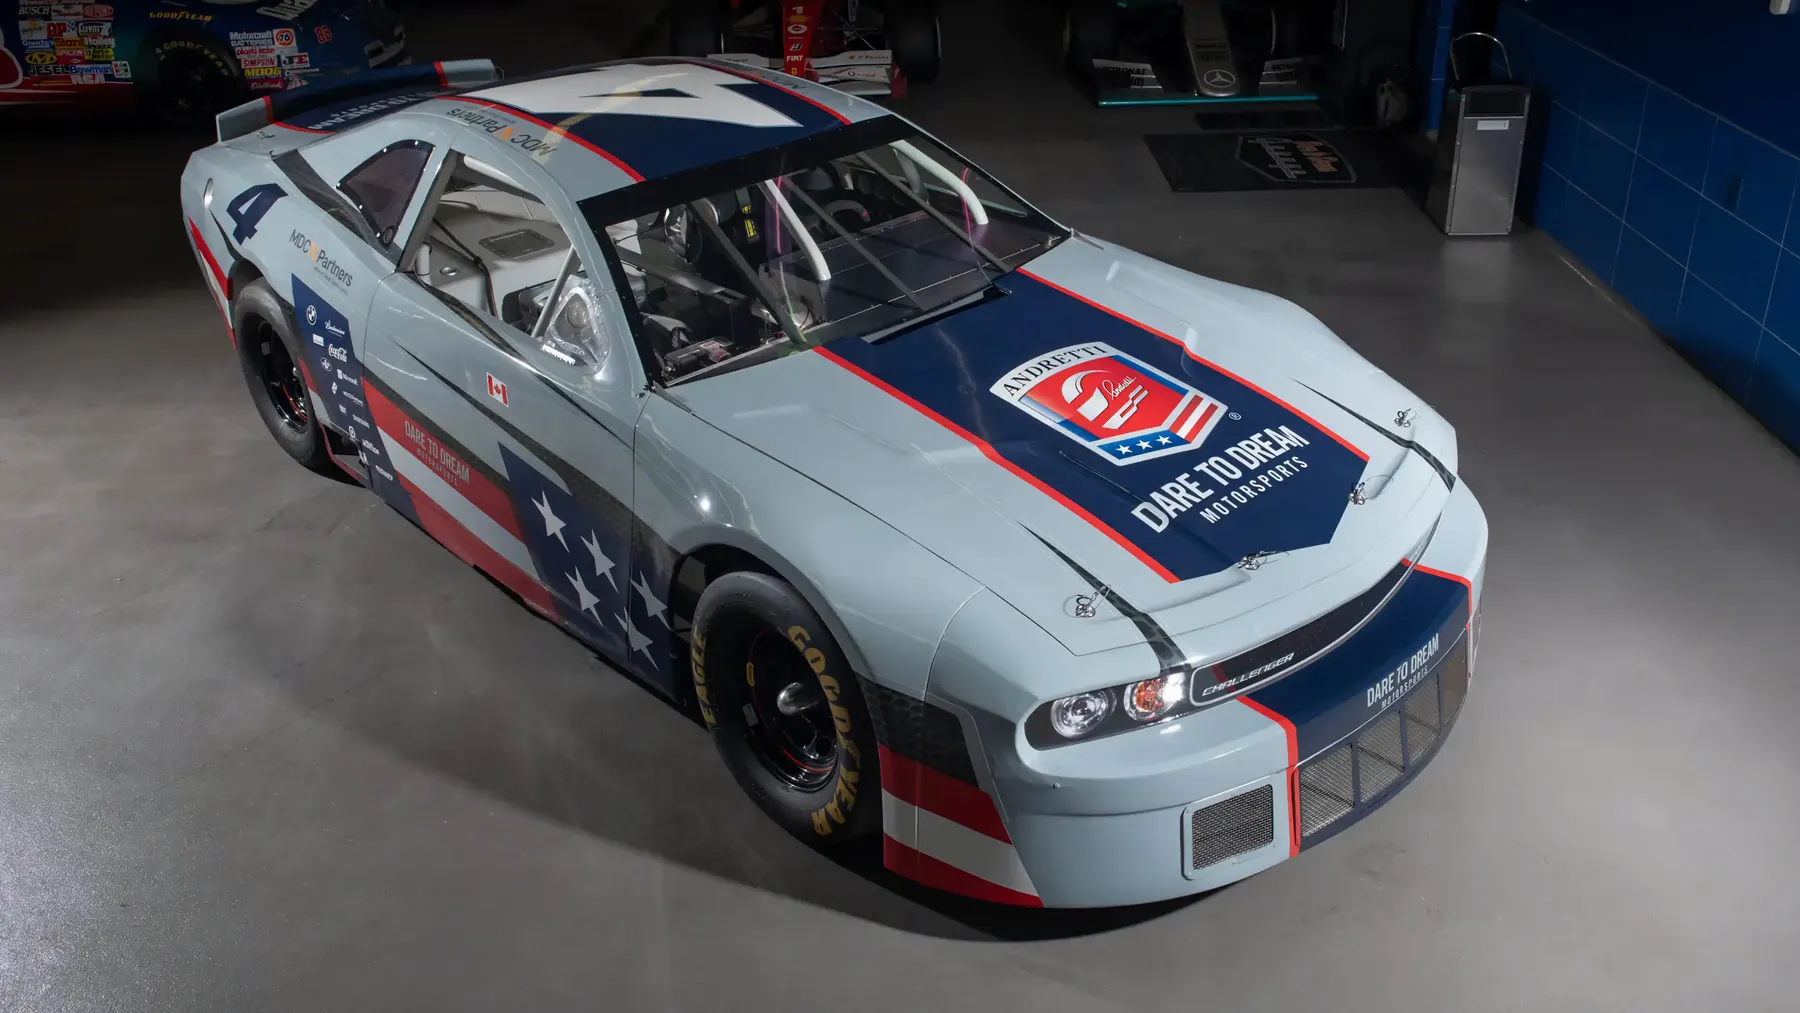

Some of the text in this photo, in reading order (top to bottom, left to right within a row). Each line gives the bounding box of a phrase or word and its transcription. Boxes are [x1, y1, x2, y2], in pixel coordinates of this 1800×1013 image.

[19, 5, 51, 16] BUSCH
[149, 10, 214, 22] GOODYEAR
[229, 31, 272, 40] Motorcraft
[231, 39, 273, 47] BATTERIES
[29, 65, 70, 75] JESEL
[70, 64, 113, 74] Bowman
[243, 58, 275, 67] SIMPSON
[244, 67, 281, 76] MOOG
[445, 107, 508, 135] Partners
[510, 133, 559, 157] MDC
[226, 183, 289, 246] 4
[289, 229, 312, 254] MDC
[316, 249, 353, 288] Partners
[1002, 344, 1109, 397] ANDRETTI
[404, 419, 427, 450] DARE
[427, 437, 439, 460] TO
[439, 447, 470, 484] DREAM
[1131, 424, 1311, 534] DARE TO DREAM
[1199, 456, 1309, 525] MOTORSPORTS
[1202, 652, 1295, 697] CHALLENGER
[1366, 633, 1440, 708] DARE TO DREAM
[1381, 665, 1429, 710] MOTORSPORTS
[788, 625, 861, 837] GOODYEAR
